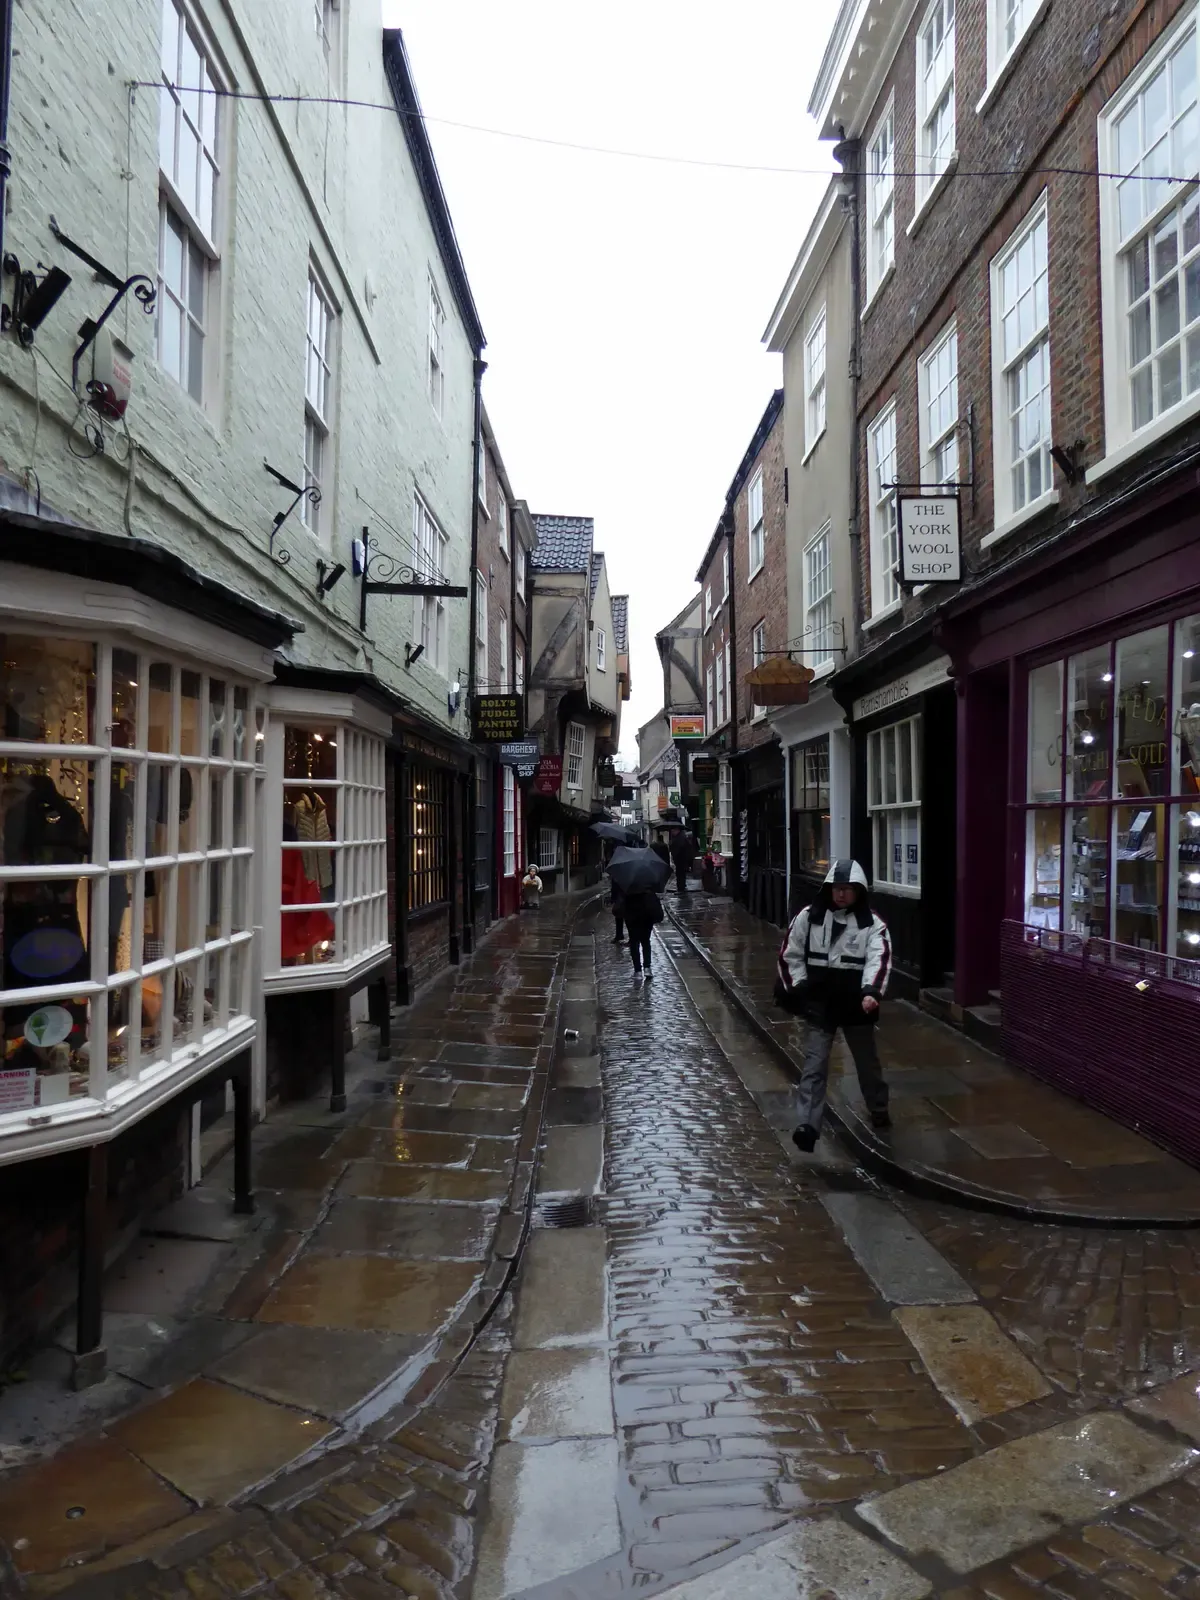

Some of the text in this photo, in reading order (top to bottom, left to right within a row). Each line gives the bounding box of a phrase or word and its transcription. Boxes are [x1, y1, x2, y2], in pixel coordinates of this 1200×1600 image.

[914, 505, 945, 516] THE
[909, 524, 951, 535] YORK
[908, 544, 954, 554] WOOL
[911, 563, 952, 574] SHOP
[860, 680, 909, 716] Ramshambles
[480, 699, 516, 707] ROLY'S
[480, 709, 517, 718] FUDGE
[477, 719, 519, 728] PANTRY
[484, 730, 514, 738] YORK
[501, 745, 537, 754] BARGHEST
[1129, 742, 1167, 767] SOLD
[0, 1070, 30, 1079] ARNING
